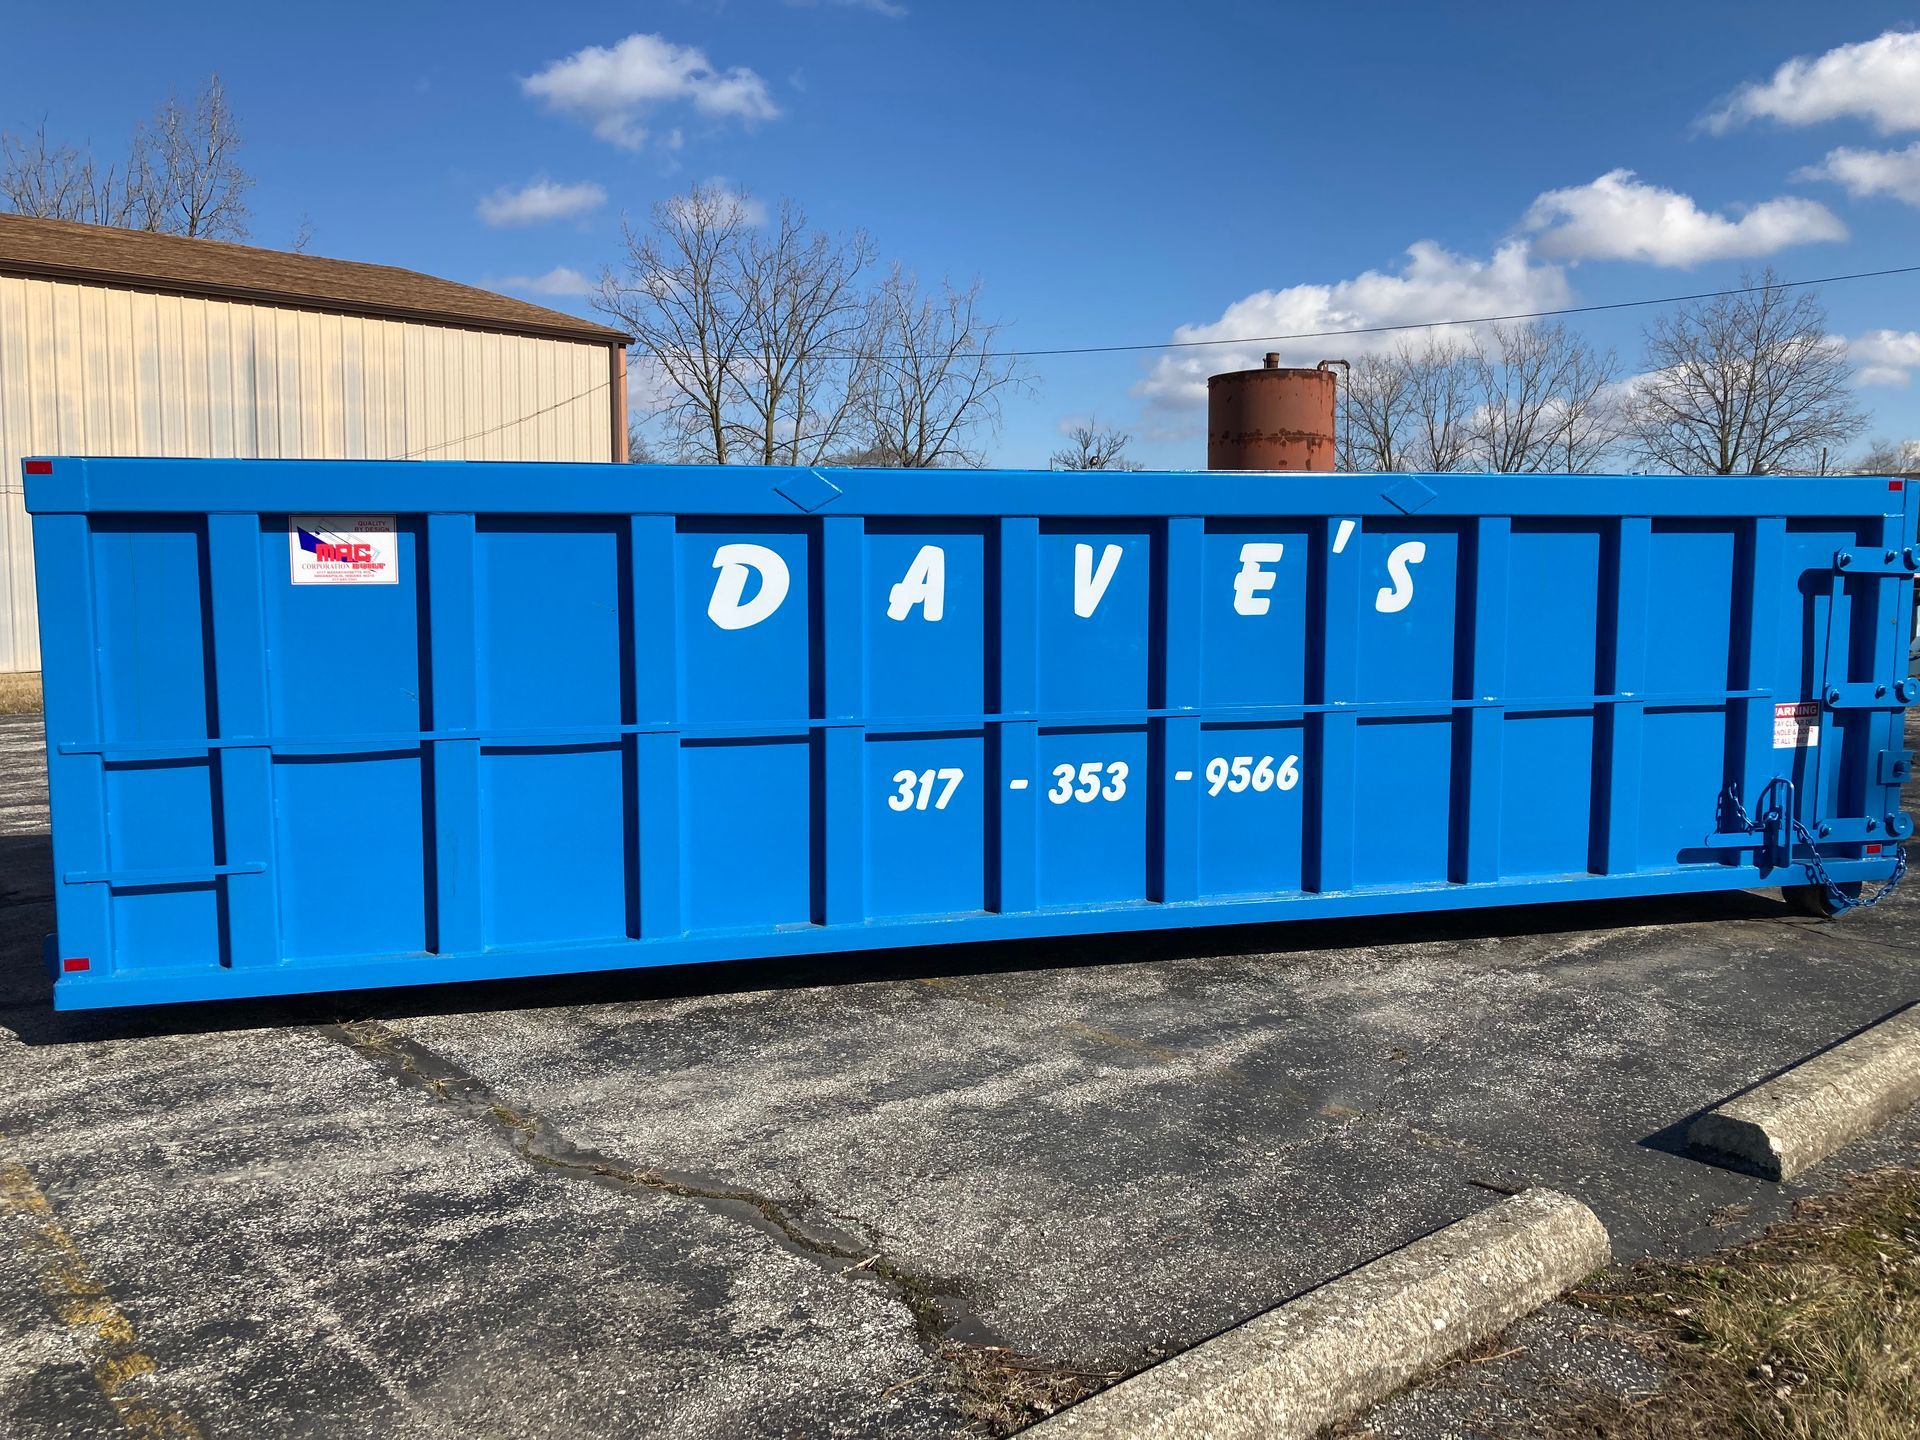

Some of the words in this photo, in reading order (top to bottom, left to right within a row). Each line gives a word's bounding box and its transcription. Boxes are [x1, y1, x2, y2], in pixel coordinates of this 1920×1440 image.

[315, 543, 372, 563] MAC
[889, 769, 963, 812] 317
[1049, 762, 1128, 805] 353
[1206, 755, 1299, 797] 9566
